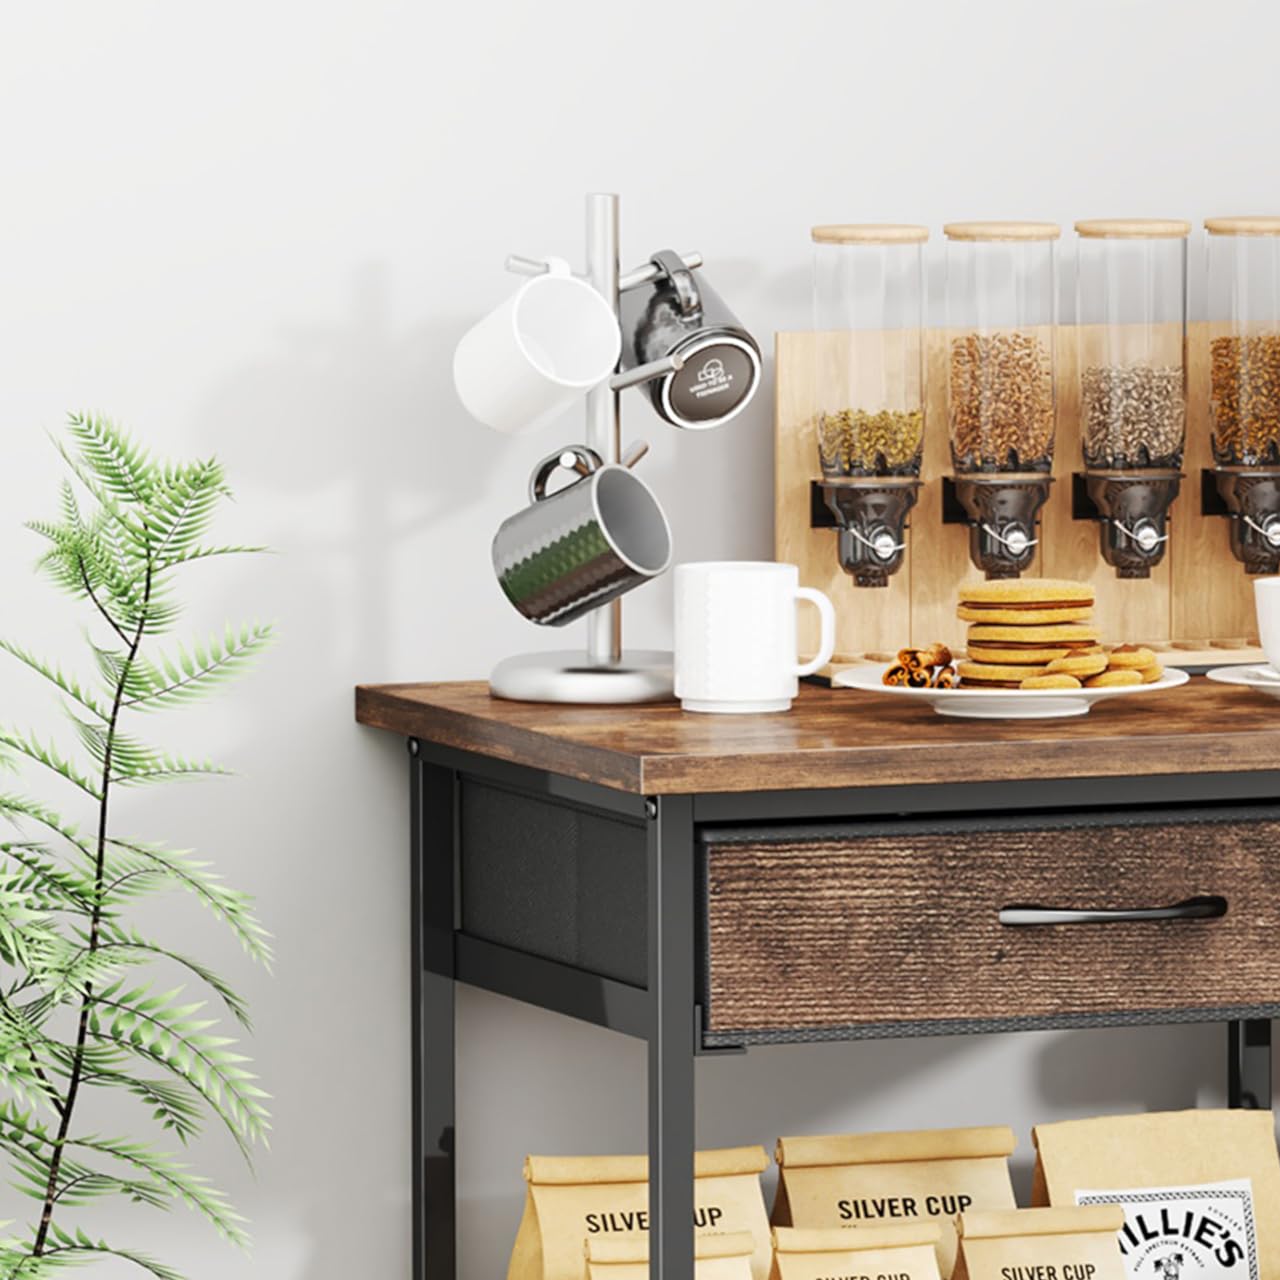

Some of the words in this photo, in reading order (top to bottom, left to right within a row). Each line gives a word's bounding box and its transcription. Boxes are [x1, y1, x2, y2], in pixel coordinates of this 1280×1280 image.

[585, 1211, 650, 1233] SILVE
[694, 1207, 723, 1228] UP
[838, 1197, 918, 1220] SILVER
[925, 1195, 972, 1216] CUP
[1118, 1208, 1245, 1268] ILLIE'S
